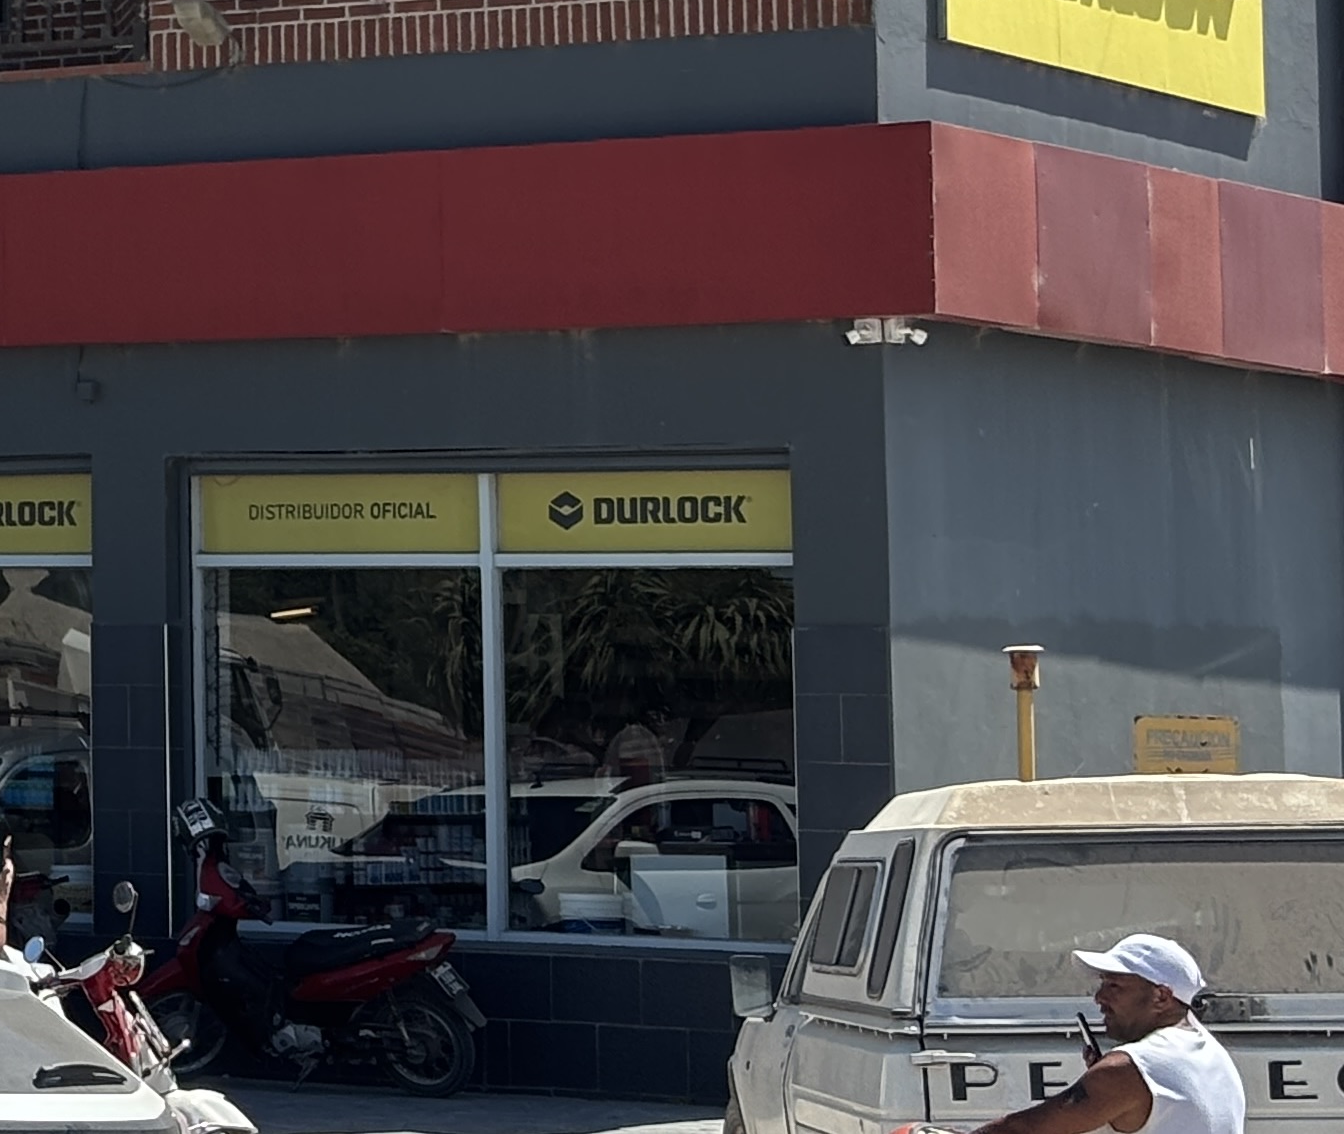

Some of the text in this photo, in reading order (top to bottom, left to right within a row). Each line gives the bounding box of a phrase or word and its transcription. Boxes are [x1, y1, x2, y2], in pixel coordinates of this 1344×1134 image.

[248, 501, 437, 521] DISTRIBUIDOR OFICIAL
[593, 494, 747, 525] DURLOCK
